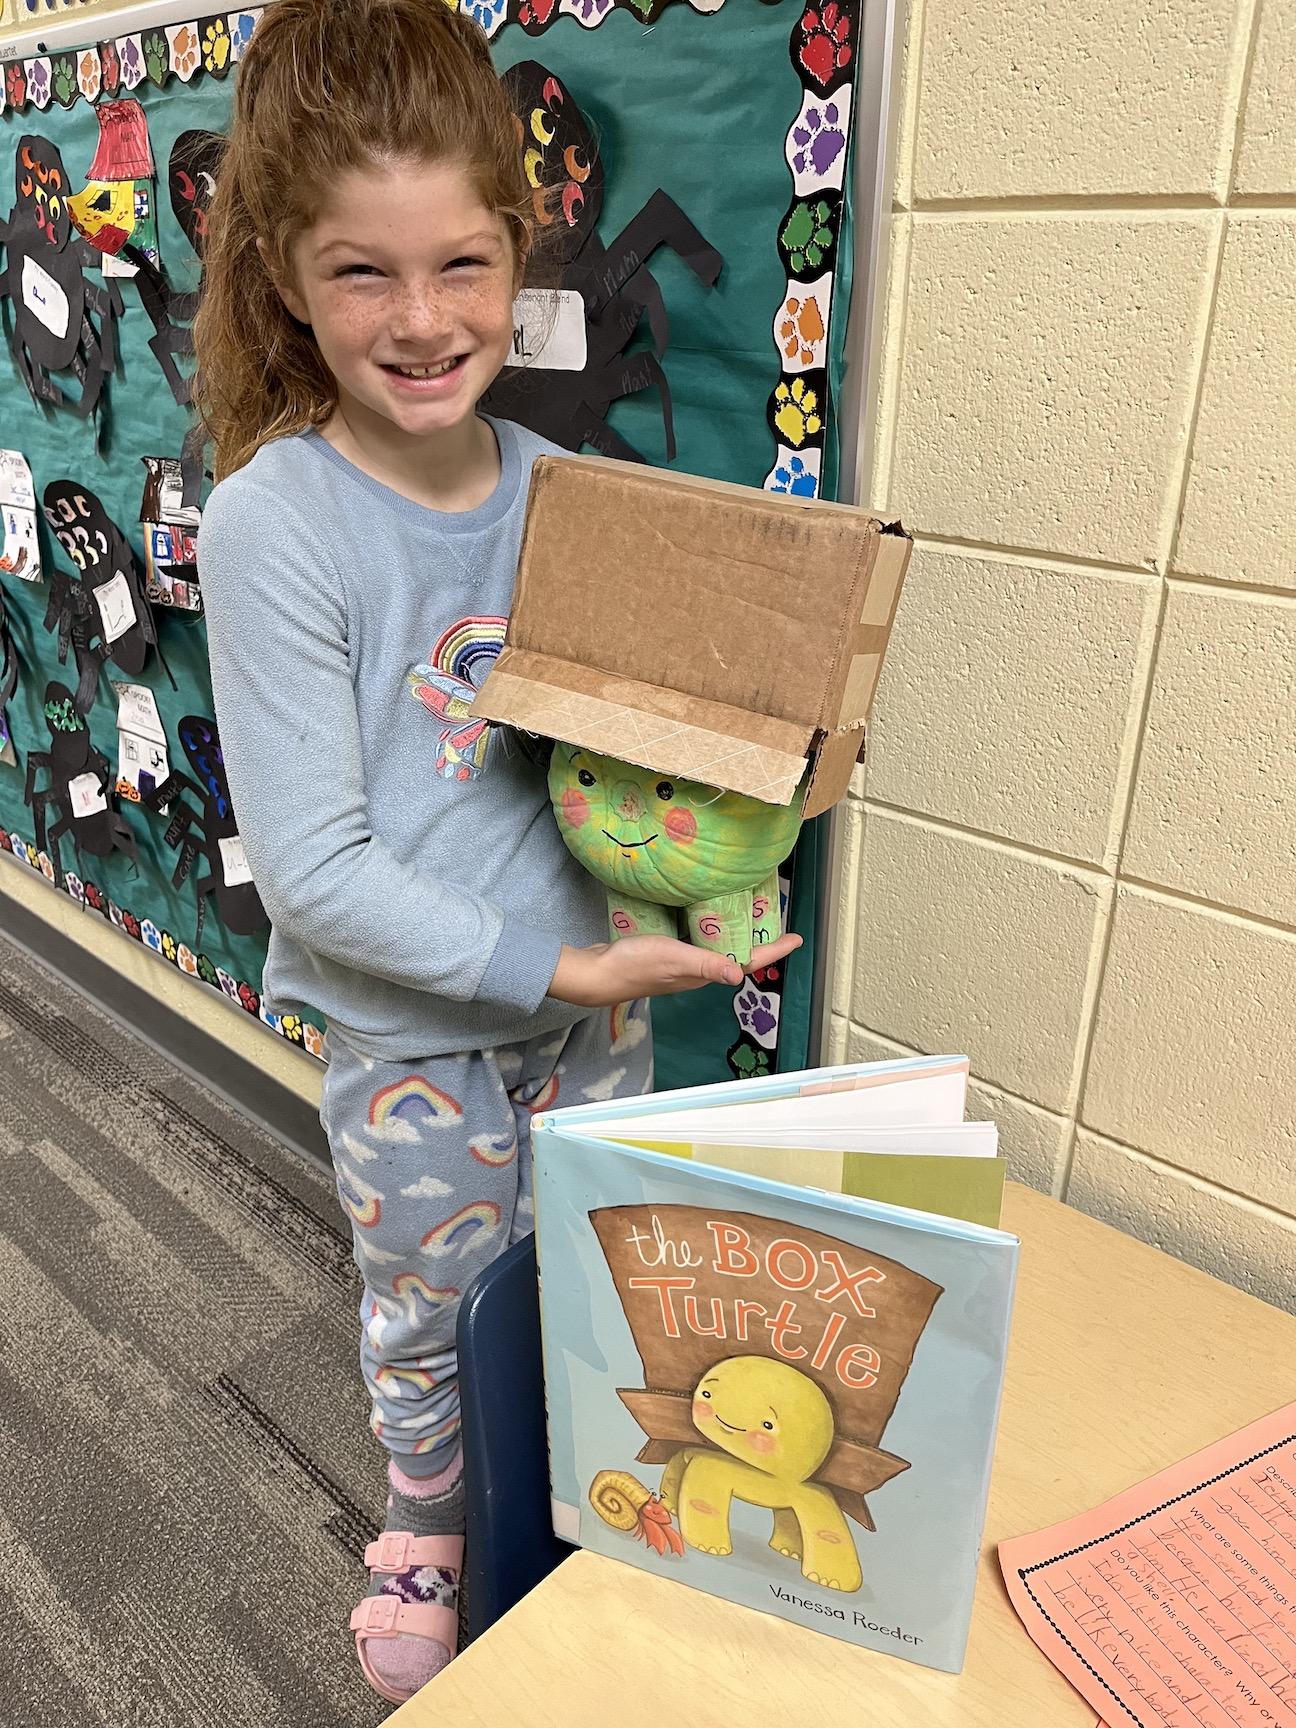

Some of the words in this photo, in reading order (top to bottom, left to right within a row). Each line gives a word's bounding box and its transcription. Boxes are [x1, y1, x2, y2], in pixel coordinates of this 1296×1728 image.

[626, 1214, 703, 1268] the
[706, 1221, 887, 1318] BOX
[628, 1276, 882, 1390] Turtle
[1189, 1506, 1216, 1532] What
[1214, 1532, 1232, 1549] are
[1231, 1548, 1259, 1576] some
[1258, 1575, 1289, 1606] things
[768, 1584, 845, 1621] Vanessa
[852, 1610, 924, 1646] Roeder
[1110, 1549, 1126, 1564] Do
[1123, 1564, 1144, 1584] you
[1142, 1583, 1160, 1601] like
[1159, 1601, 1178, 1619] this
[1176, 1620, 1233, 1676] character?
[1235, 1680, 1261, 1706] Why
[1260, 1709, 1275, 1721] or
